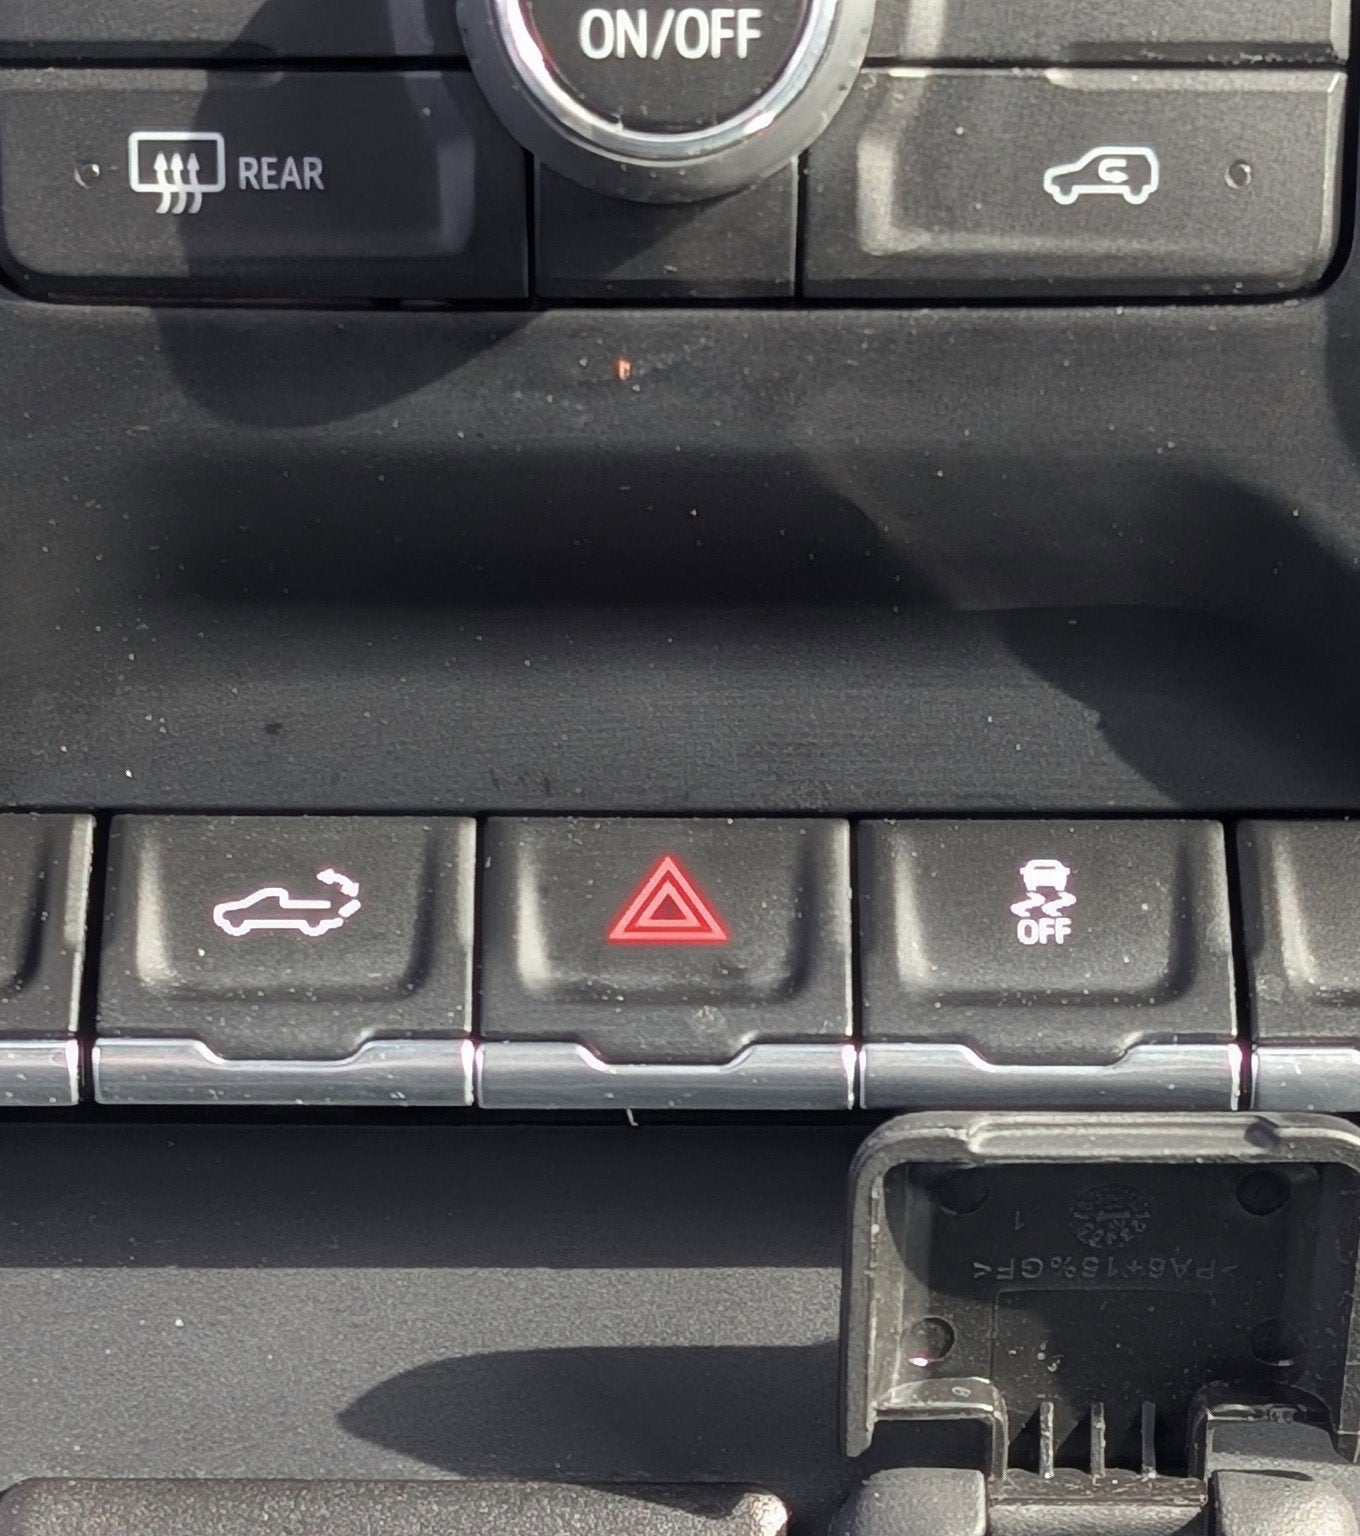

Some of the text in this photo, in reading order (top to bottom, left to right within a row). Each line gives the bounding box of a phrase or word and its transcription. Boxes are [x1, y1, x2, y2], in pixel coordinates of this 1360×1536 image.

[578, 7, 763, 61] ON/OFF
[238, 156, 324, 190] REAR
[1016, 917, 1072, 945] OFF
